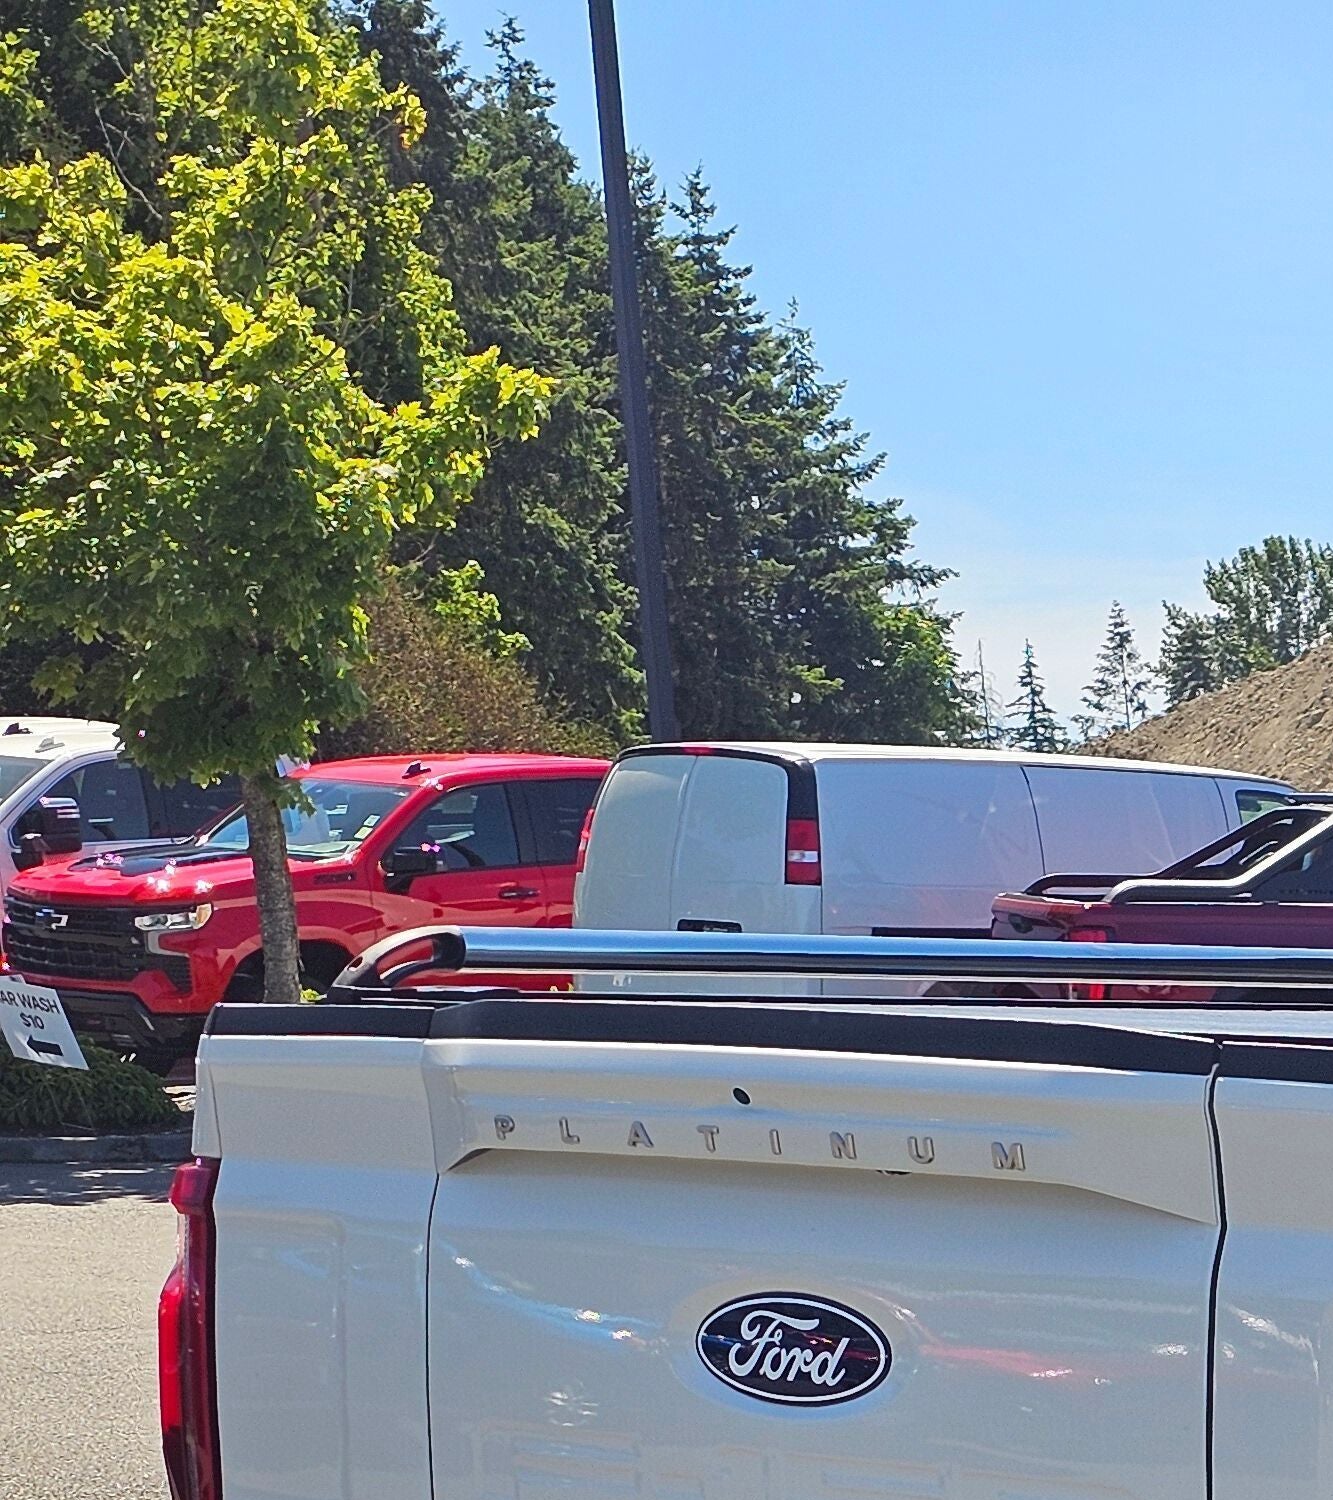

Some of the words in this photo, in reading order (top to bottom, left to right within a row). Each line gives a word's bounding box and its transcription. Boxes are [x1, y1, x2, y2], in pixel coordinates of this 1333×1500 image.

[0, 990, 19, 1007] AR
[18, 993, 60, 1015] WASH
[493, 1114, 1027, 1171] PLATINUM
[728, 1309, 850, 1387] Ford
